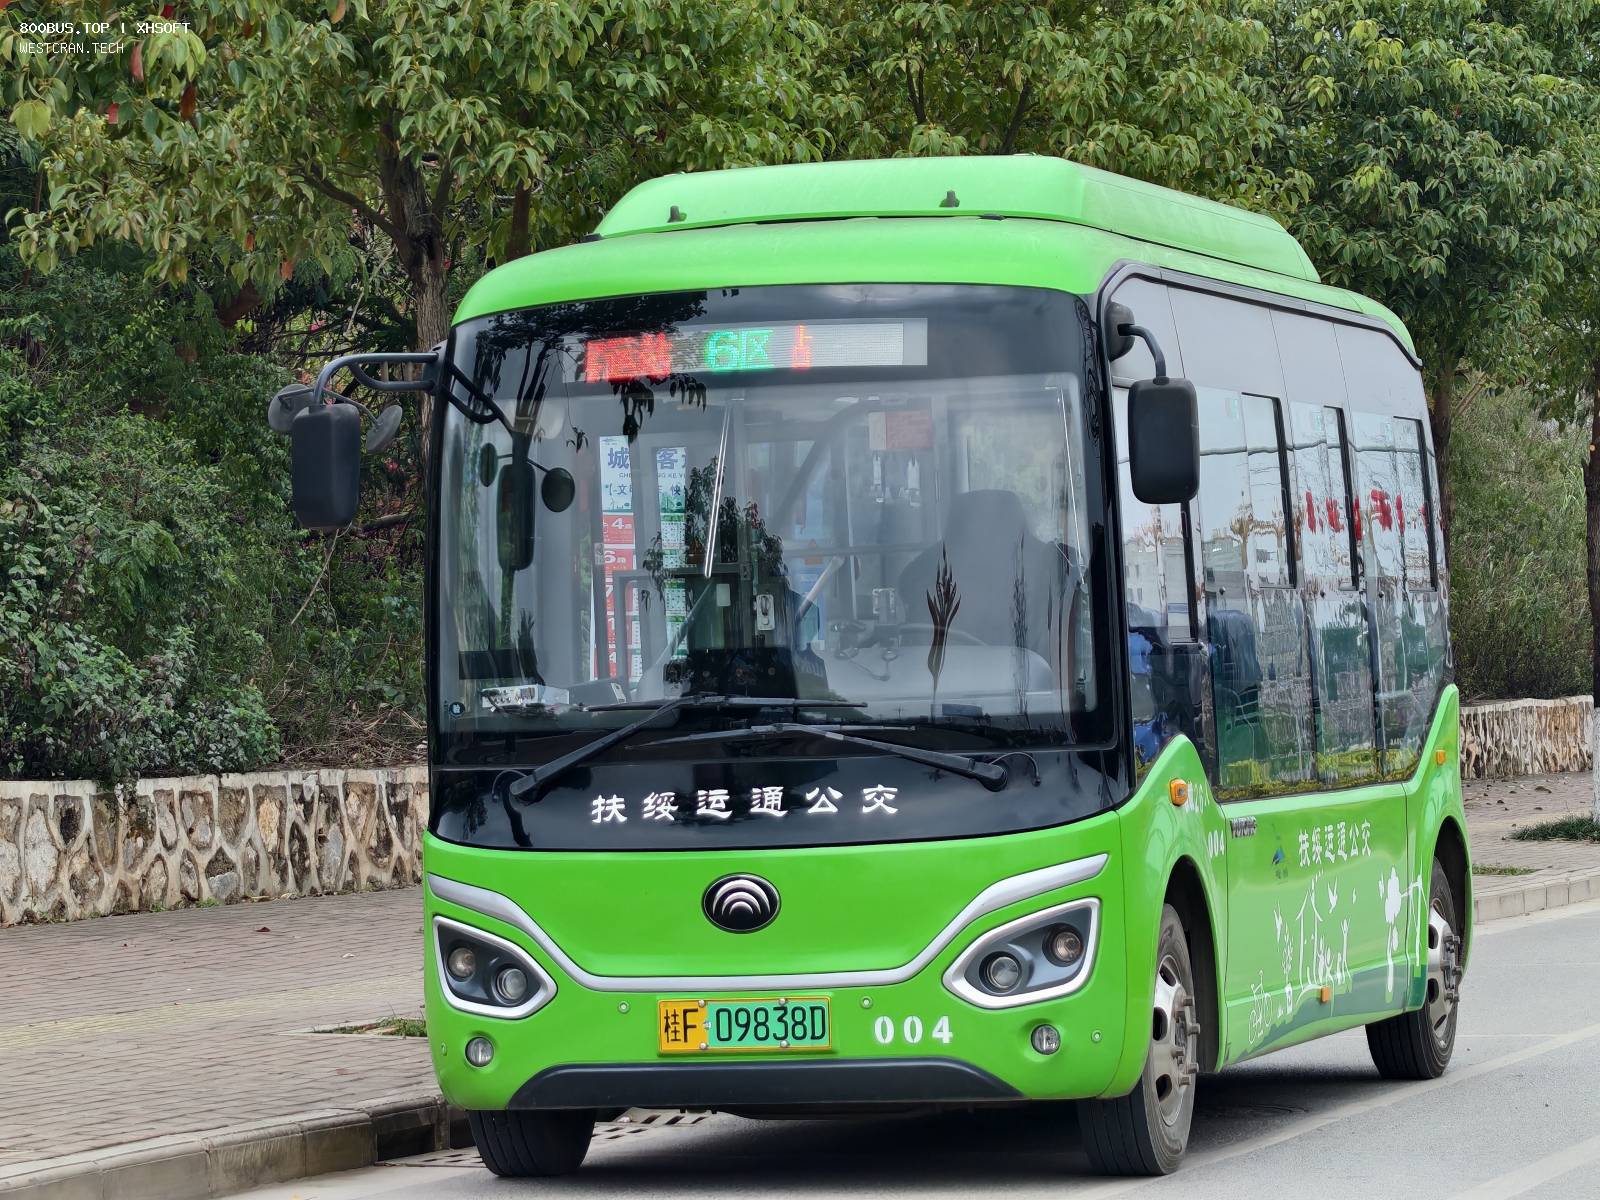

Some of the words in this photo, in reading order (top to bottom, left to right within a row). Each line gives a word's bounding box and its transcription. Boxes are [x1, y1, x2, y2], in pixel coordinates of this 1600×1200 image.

[591, 783, 900, 825] 扶绥运通公交
[1207, 829, 1225, 859] 004
[664, 1006, 699, 1044] 桂F
[715, 1005, 826, 1043] 09838D
[873, 1015, 954, 1045] 004
